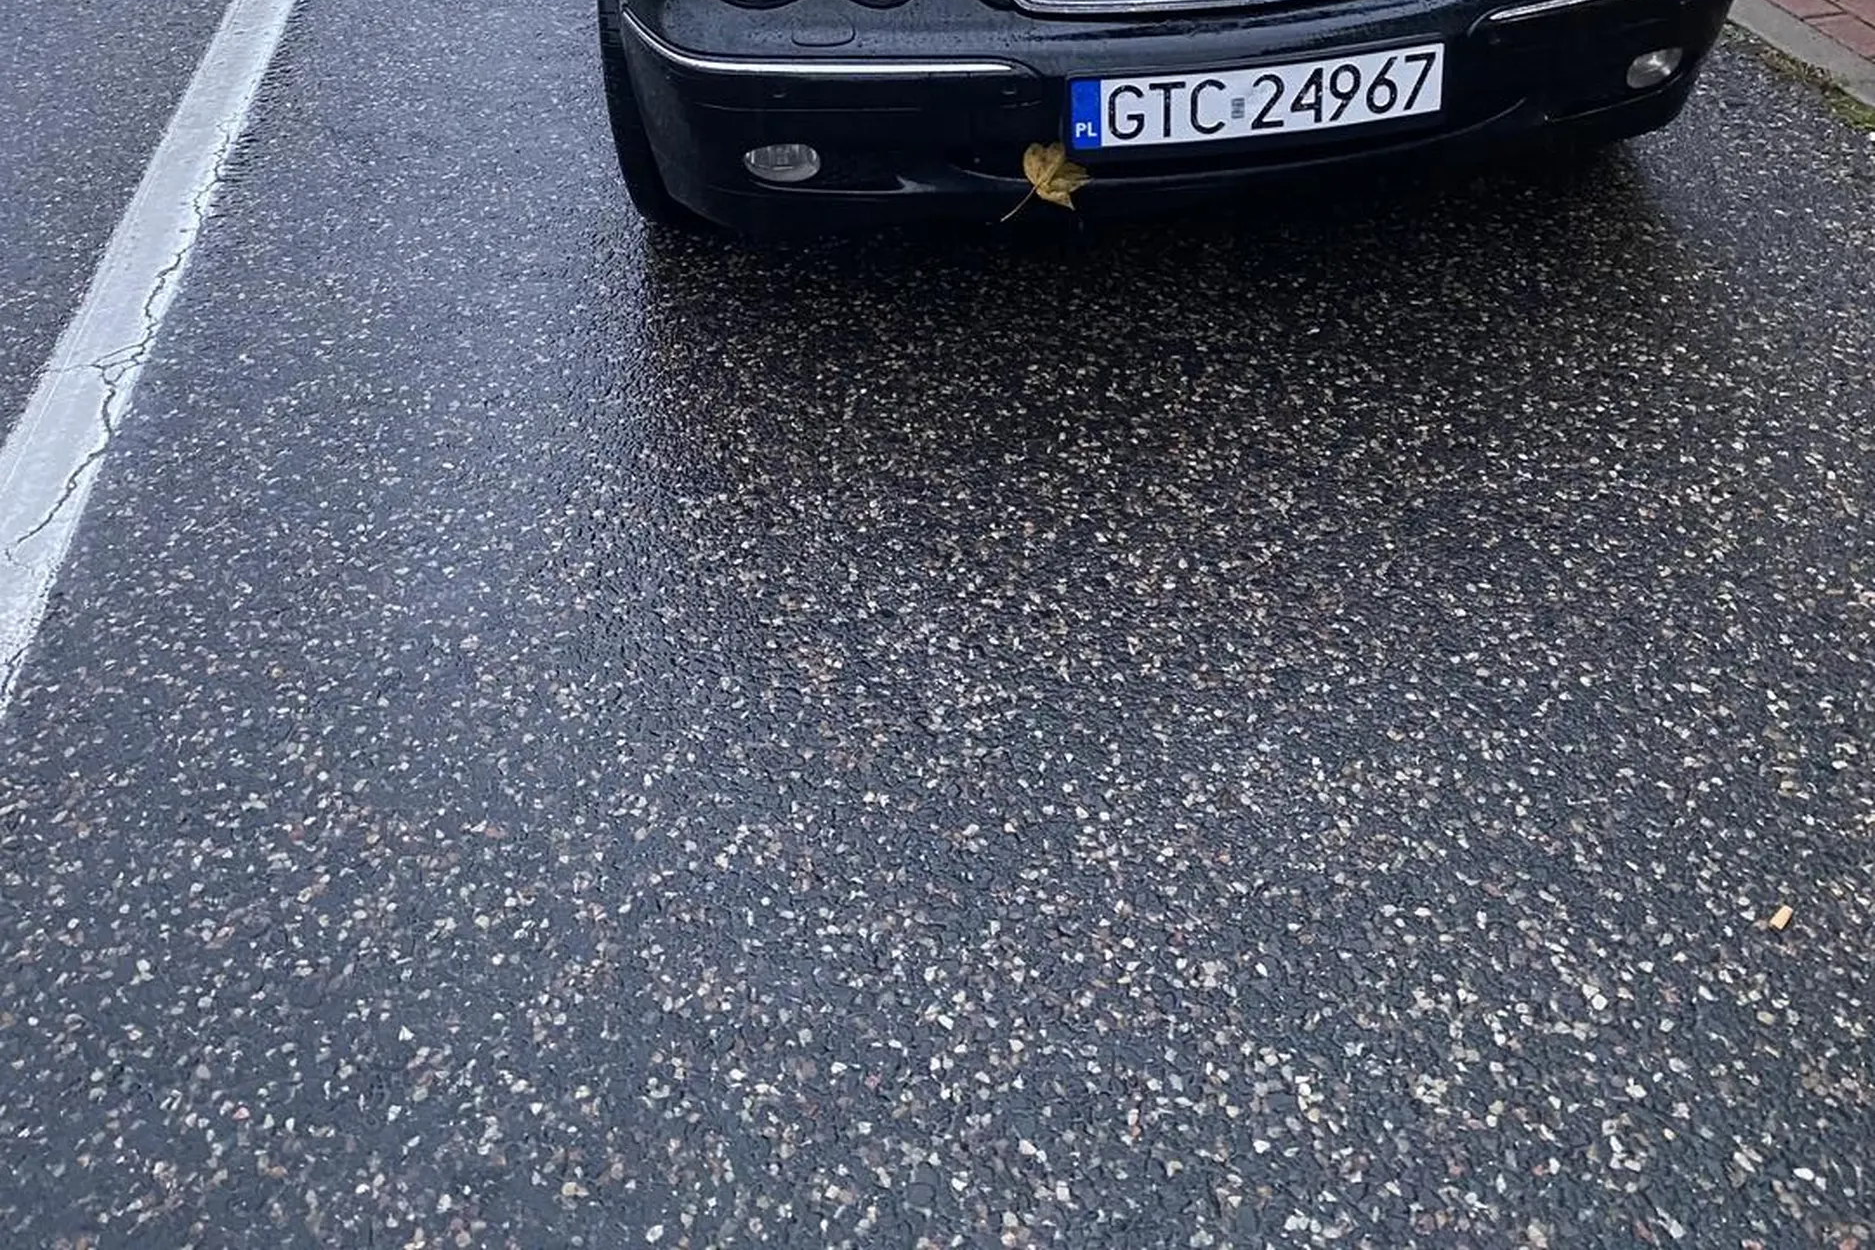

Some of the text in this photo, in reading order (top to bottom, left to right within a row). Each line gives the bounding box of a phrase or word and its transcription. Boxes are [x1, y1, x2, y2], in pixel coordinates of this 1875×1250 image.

[1076, 52, 1437, 140] PL GTC 24967
